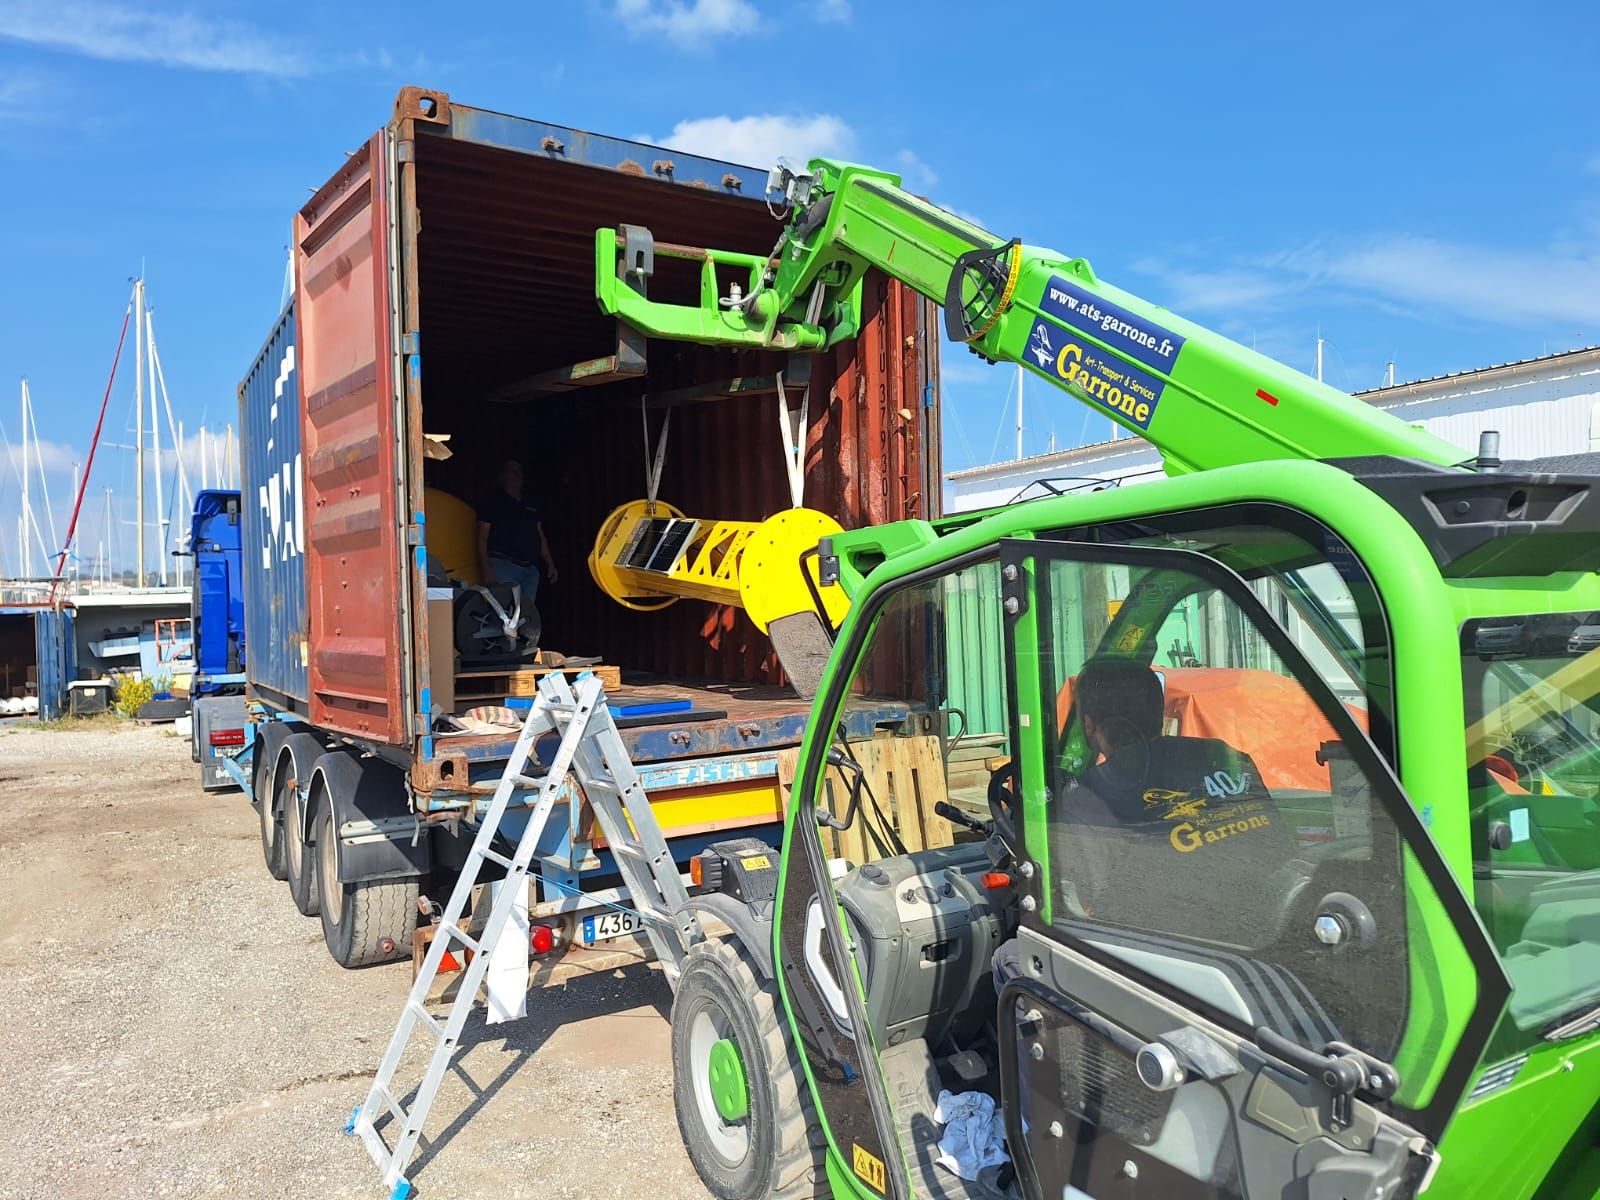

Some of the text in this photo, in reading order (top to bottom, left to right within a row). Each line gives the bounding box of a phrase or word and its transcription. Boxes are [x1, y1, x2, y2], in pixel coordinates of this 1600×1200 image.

[1050, 288, 1174, 357] www.ats-garrone.fr
[1057, 343, 1149, 422] Garrone
[1130, 380, 1156, 401] Services
[1170, 814, 1270, 853] Garrone
[599, 913, 632, 935] 436
